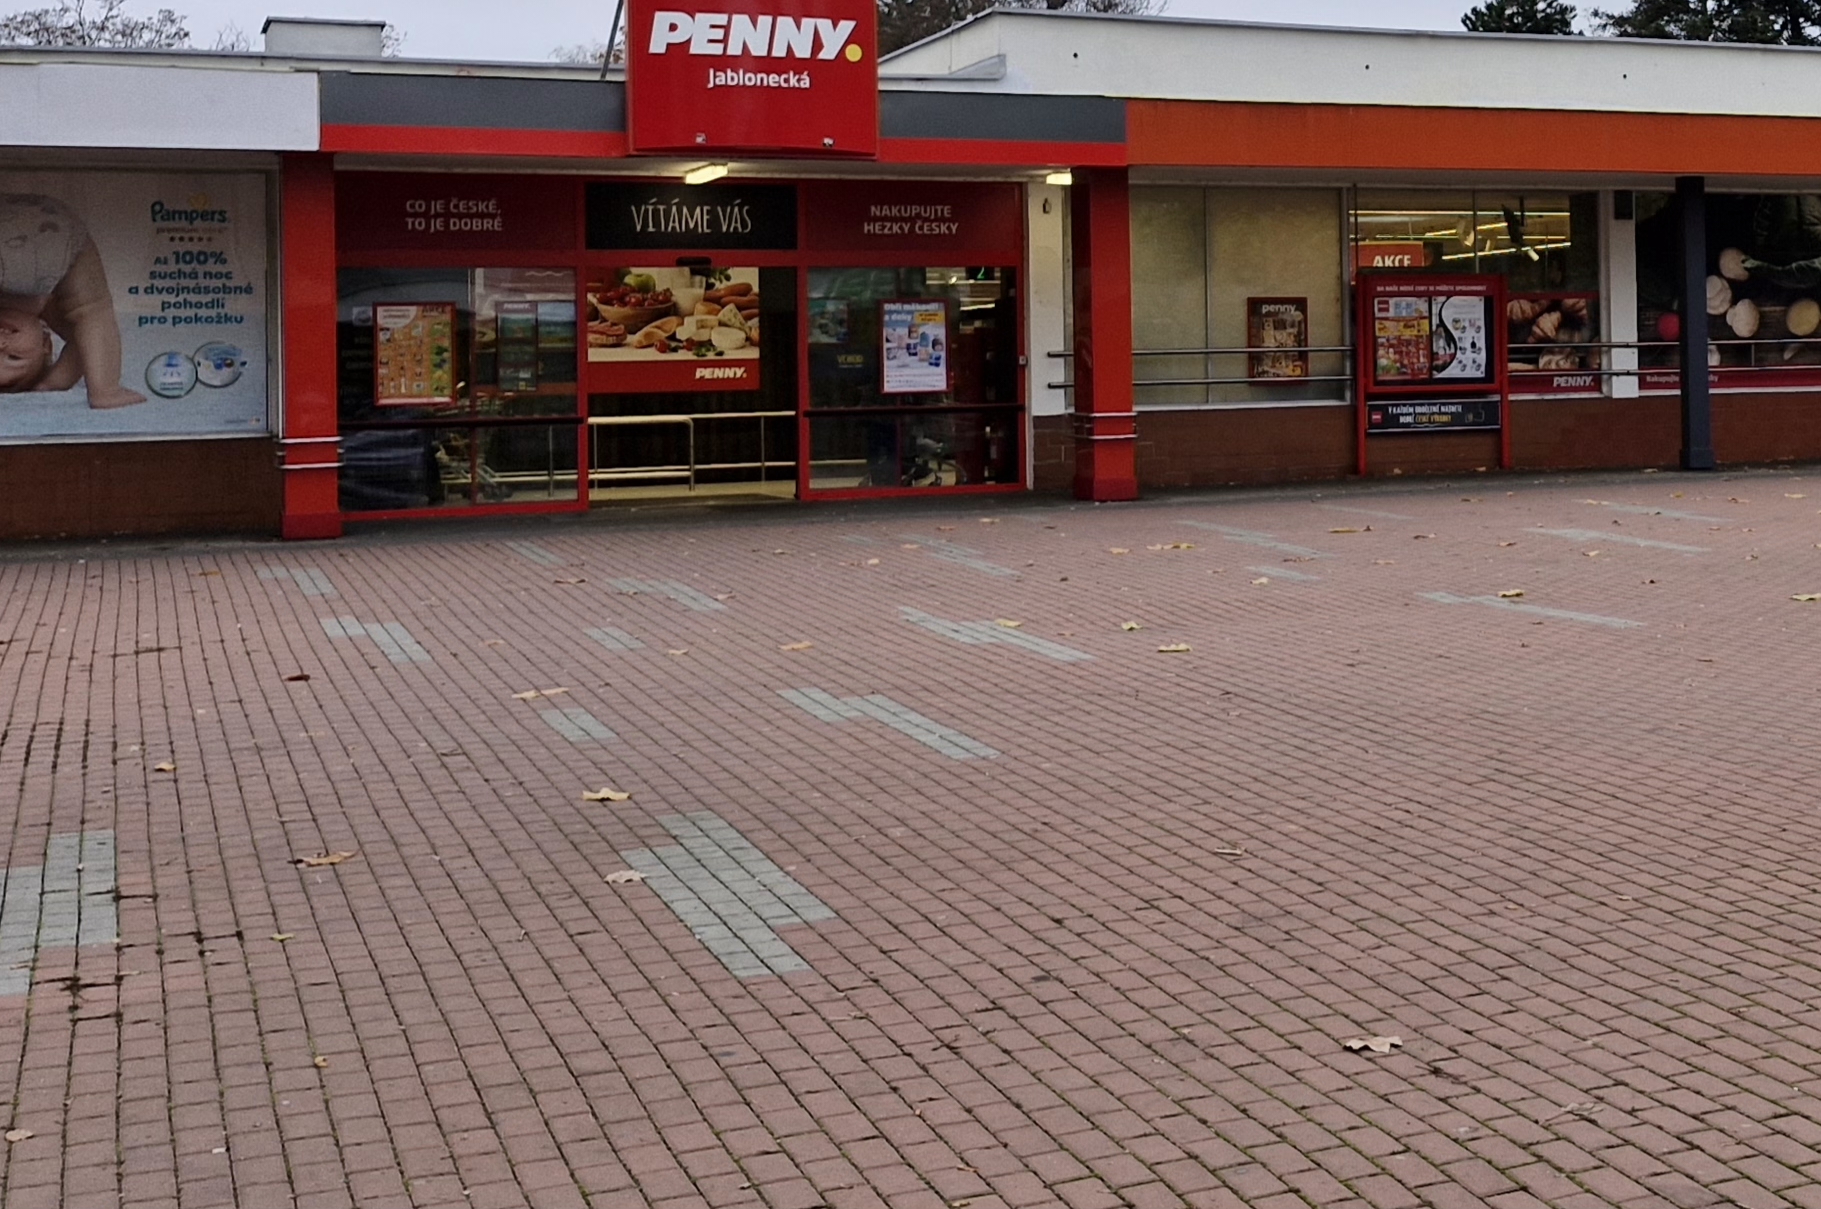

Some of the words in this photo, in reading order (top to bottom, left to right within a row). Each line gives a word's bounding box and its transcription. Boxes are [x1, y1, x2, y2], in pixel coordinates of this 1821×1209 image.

[707, 69, 811, 89] Jablonecká
[150, 201, 228, 226] Pampers
[406, 200, 426, 213] CO
[430, 200, 445, 215] JE
[870, 205, 952, 219] NAKUPUJTE
[631, 198, 712, 233] VÍTÁME
[717, 199, 752, 233] VÁS
[405, 218, 426, 231] TO
[429, 218, 445, 233] JE
[449, 214, 503, 231] DOBRÉ
[863, 221, 911, 235] HEZKY
[915, 220, 960, 235] ČESKY
[173, 250, 228, 265] 100%
[149, 268, 199, 280] suchá
[203, 270, 233, 280] noc
[128, 285, 139, 295] a
[143, 281, 254, 298] dvojnásobné
[161, 297, 225, 312] pohodlí
[1262, 304, 1297, 314] penny
[138, 315, 168, 327] pro
[172, 312, 244, 327] pokožku
